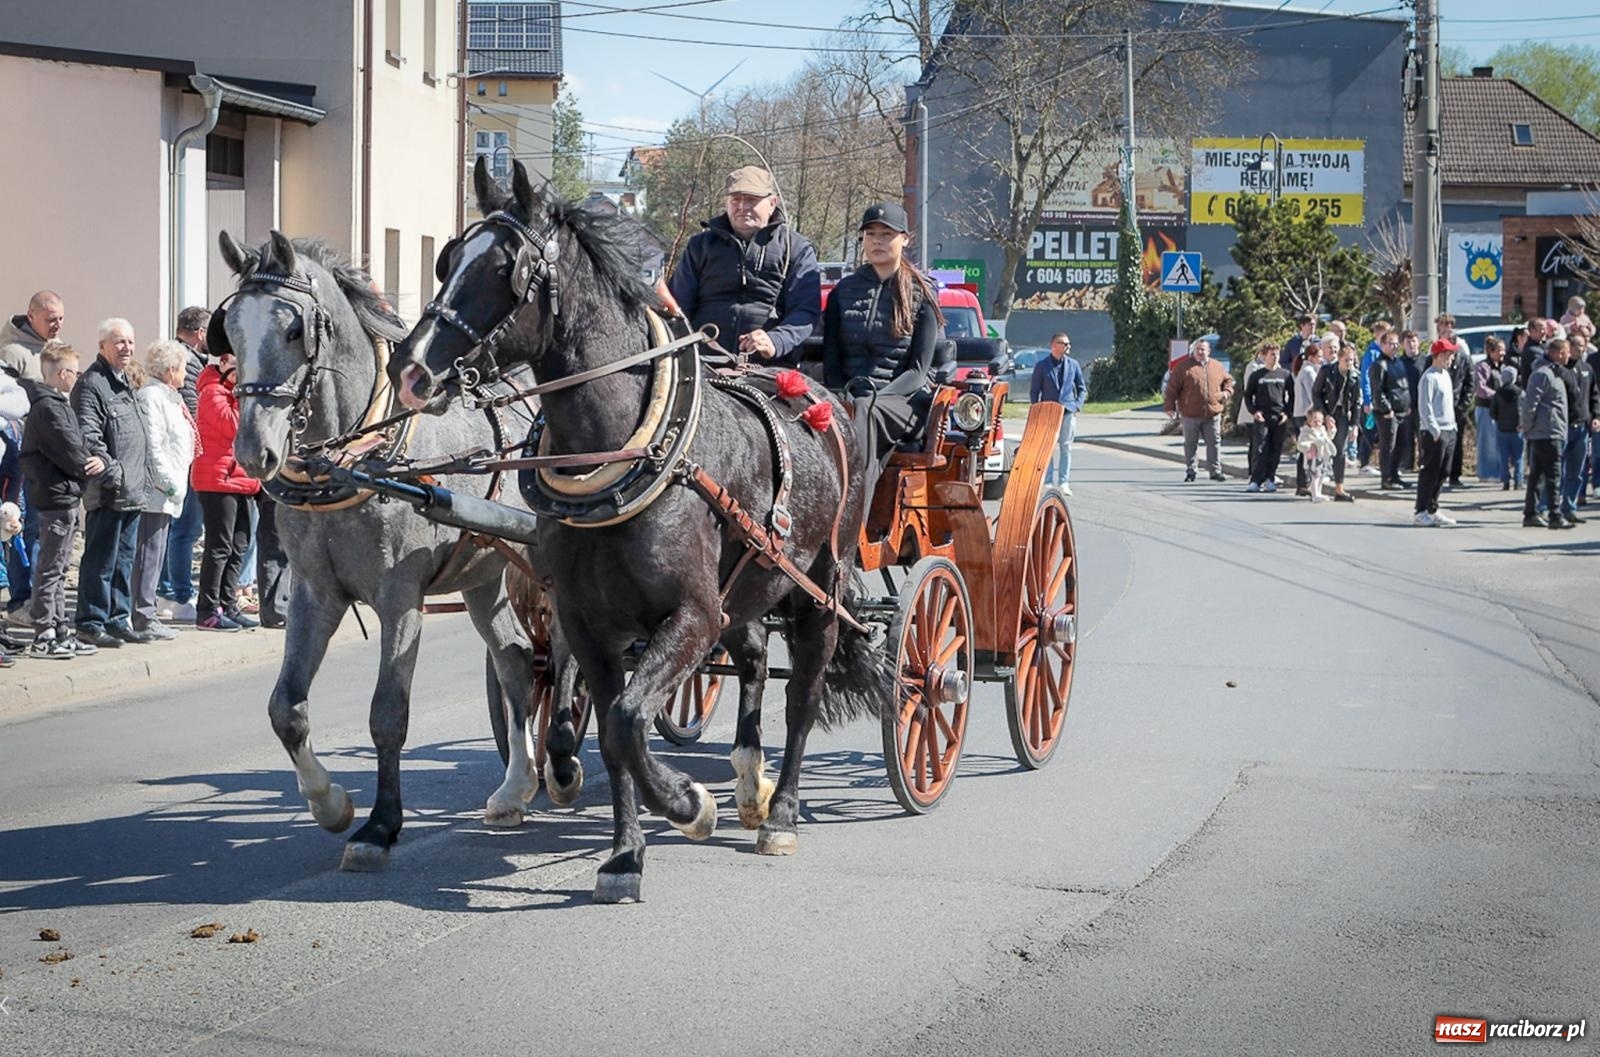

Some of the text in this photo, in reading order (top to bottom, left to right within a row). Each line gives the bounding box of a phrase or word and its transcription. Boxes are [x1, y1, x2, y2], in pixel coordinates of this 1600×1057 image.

[1299, 153, 1350, 173] TWOJĄ
[1026, 231, 1120, 260] PELLET
[1037, 268, 1120, 284] 604 506 255
